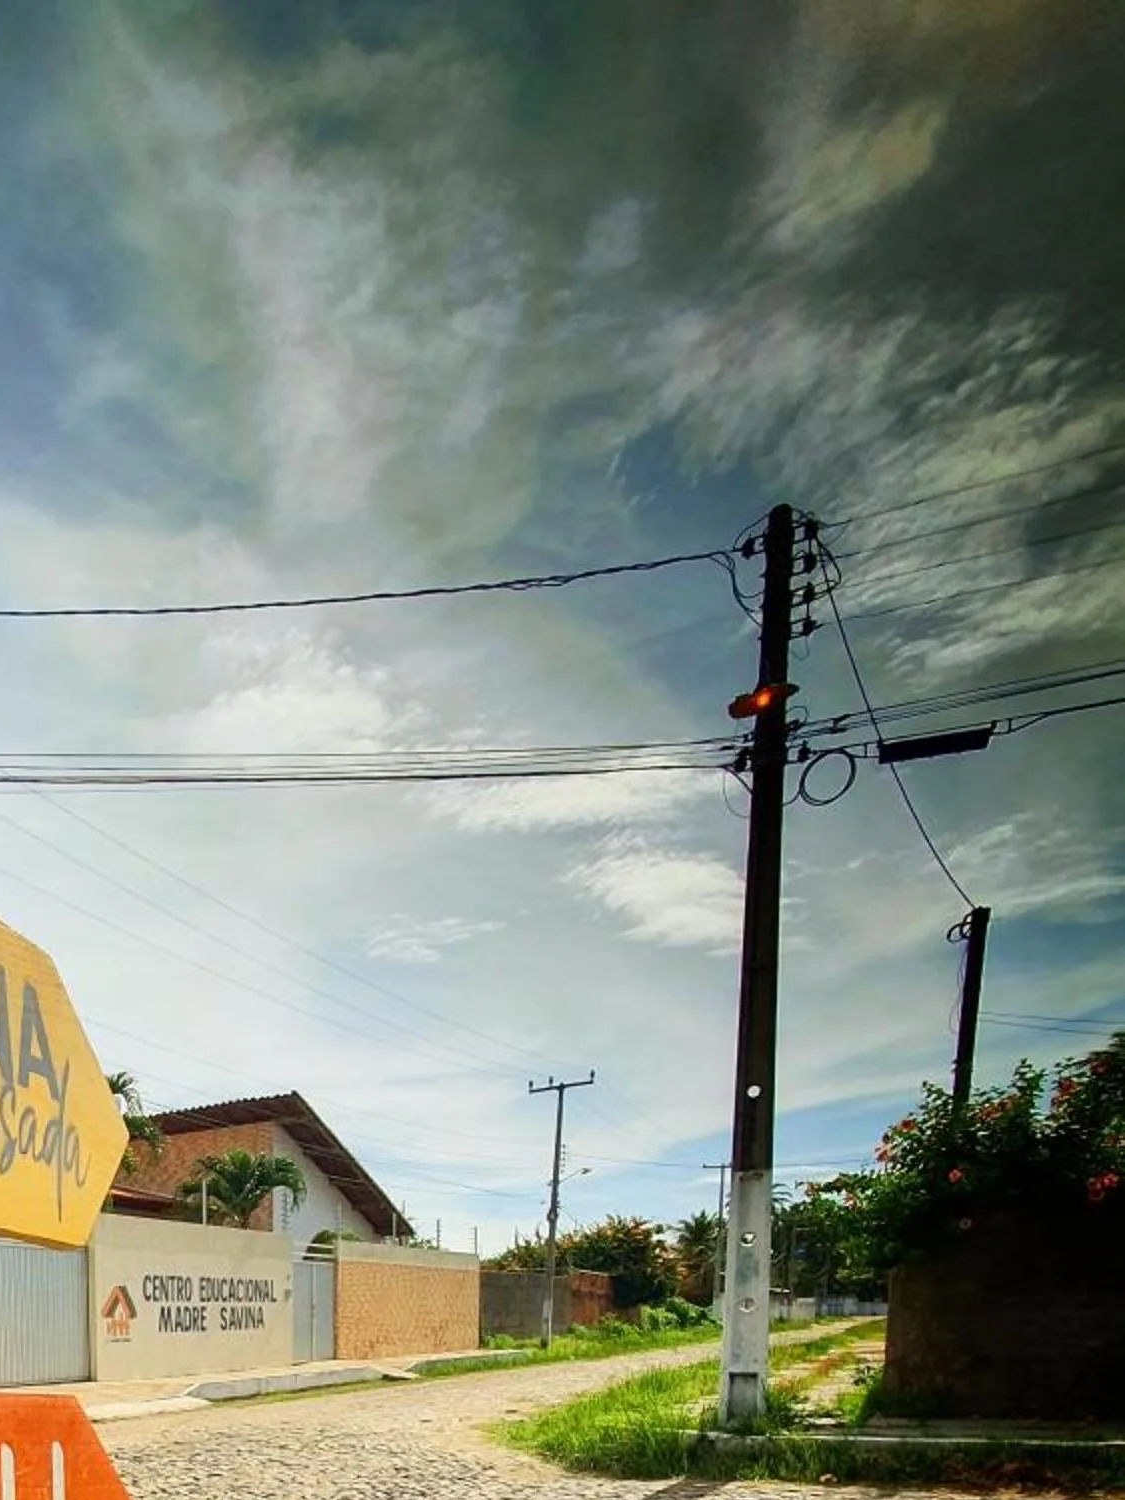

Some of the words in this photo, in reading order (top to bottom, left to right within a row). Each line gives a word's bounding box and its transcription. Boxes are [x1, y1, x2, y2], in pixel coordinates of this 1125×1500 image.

[143, 1275, 193, 1302] CENTRO
[199, 1276, 278, 1303] EDUCACIONAL
[158, 1305, 207, 1333] MADRE
[220, 1305, 265, 1331] SAVINA
